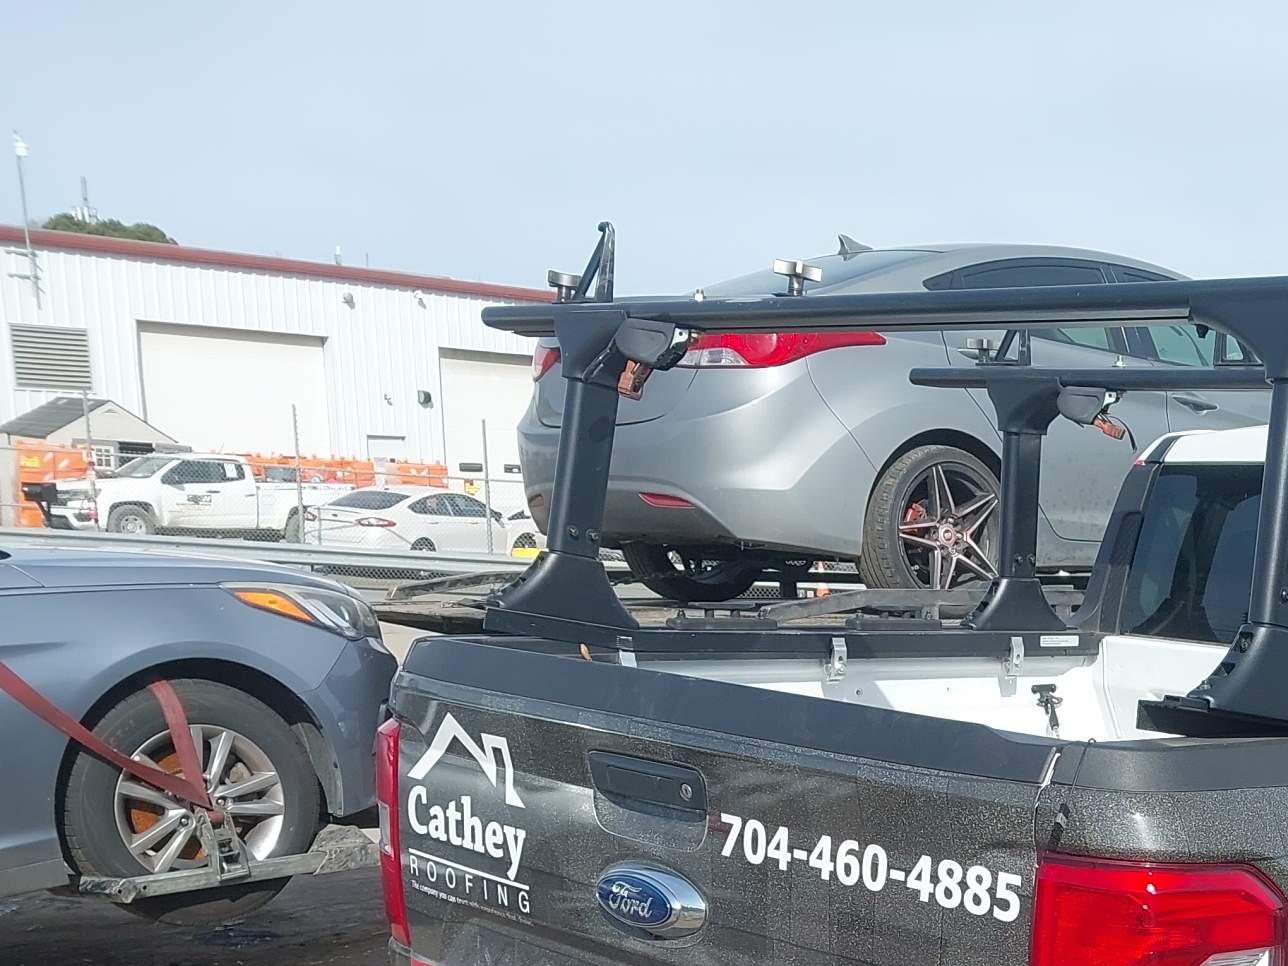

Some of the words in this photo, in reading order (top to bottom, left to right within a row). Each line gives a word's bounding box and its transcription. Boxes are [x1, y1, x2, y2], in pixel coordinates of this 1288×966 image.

[407, 784, 526, 880] Cathey
[721, 813, 1021, 921] 704-460-4885
[409, 856, 531, 914] ROOFING
[608, 881, 656, 918] Ford
